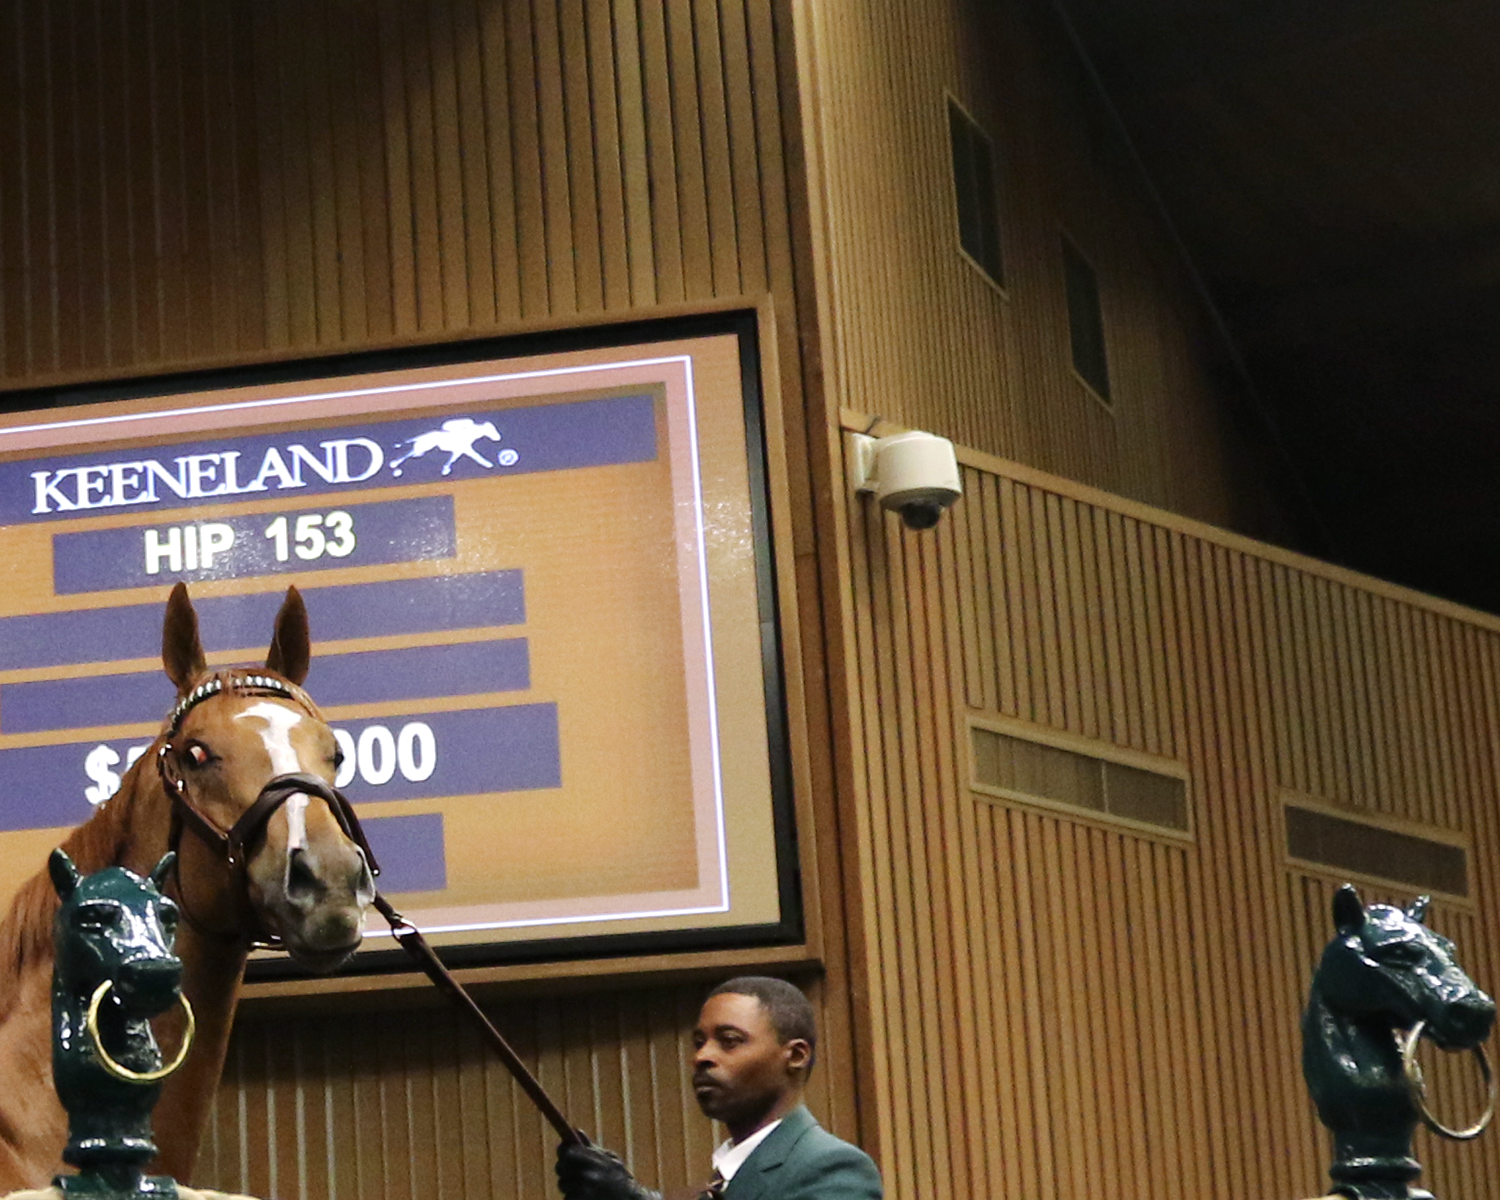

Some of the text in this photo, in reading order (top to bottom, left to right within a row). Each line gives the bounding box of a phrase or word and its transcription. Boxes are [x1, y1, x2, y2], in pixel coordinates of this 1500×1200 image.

[32, 438, 384, 514] KEENELAND
[144, 511, 355, 574] HIP 153
